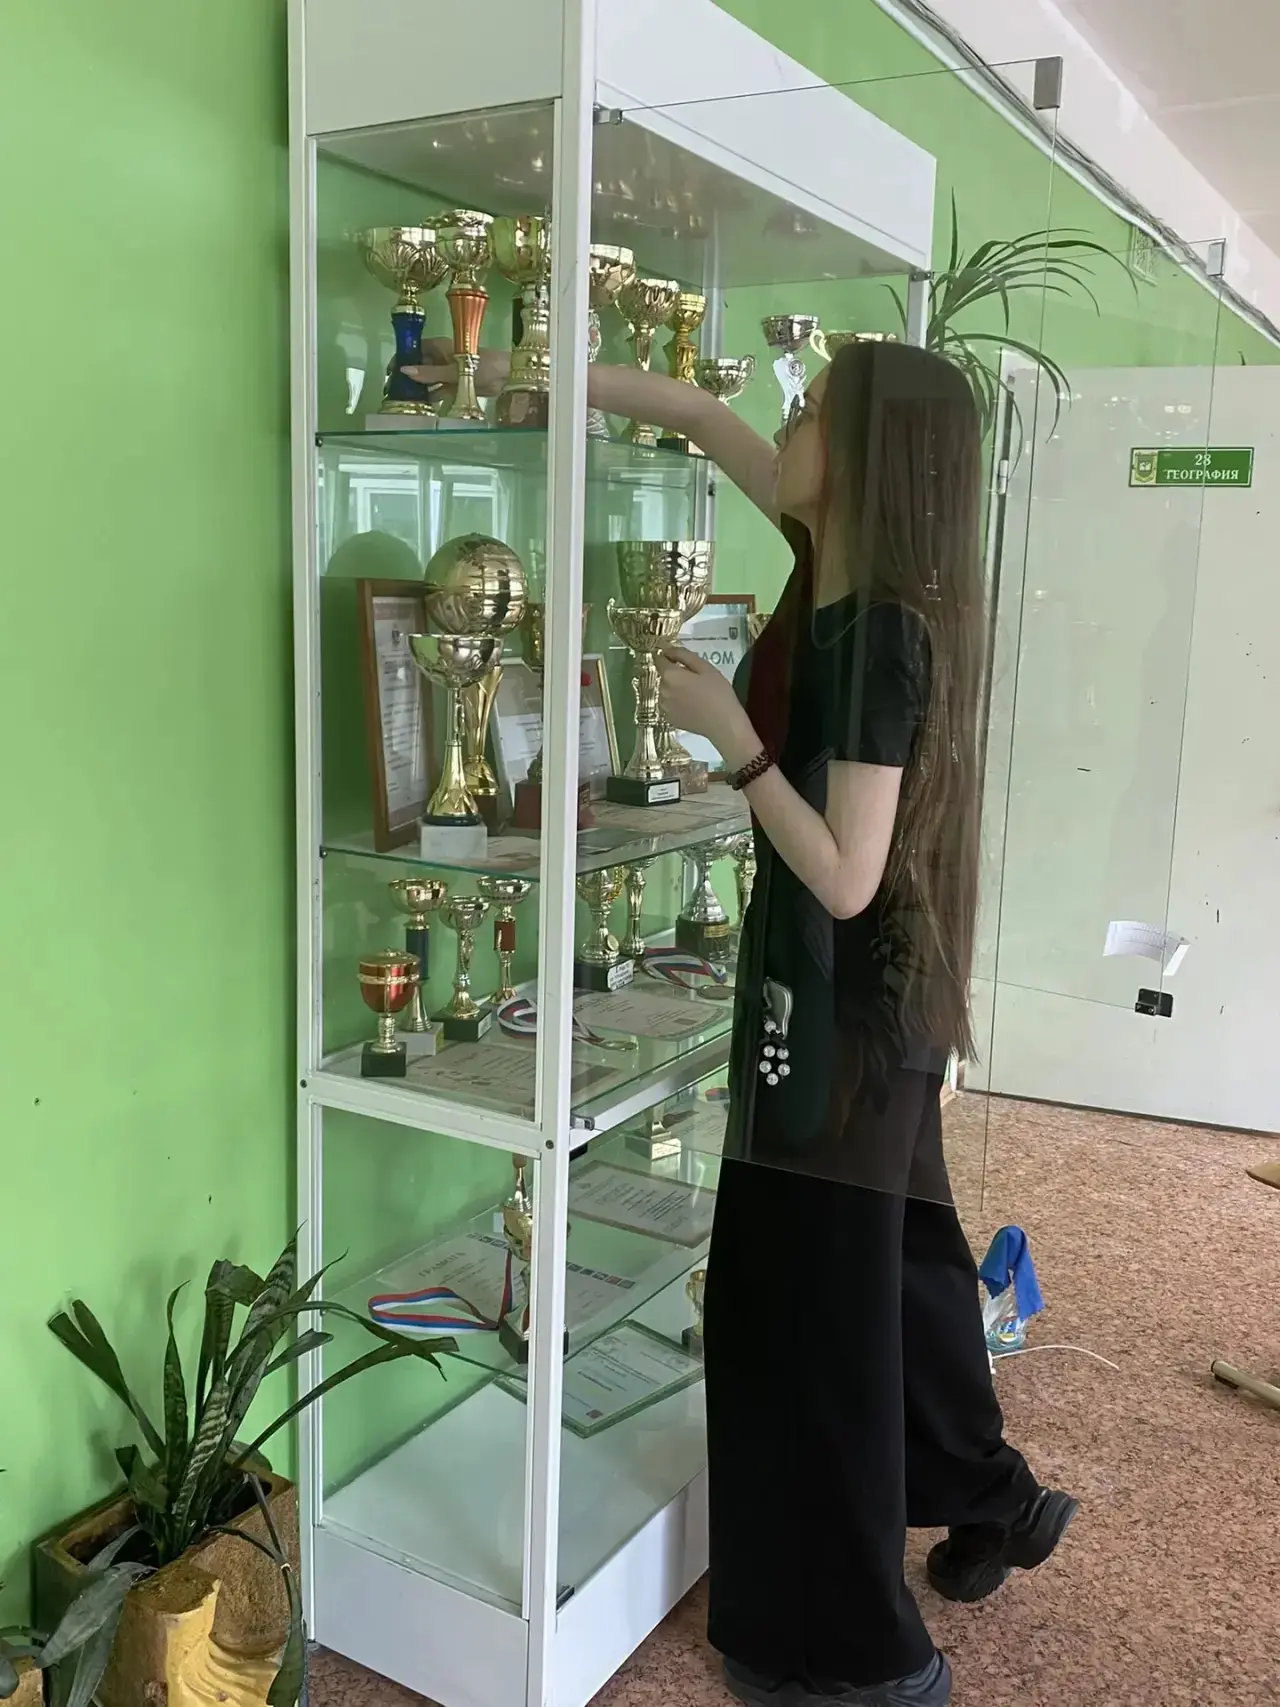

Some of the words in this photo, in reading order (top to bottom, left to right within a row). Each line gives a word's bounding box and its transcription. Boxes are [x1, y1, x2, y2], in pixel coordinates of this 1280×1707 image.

[1195, 453, 1212, 466] 28
[1166, 468, 1239, 480] ГЕОГРАФИЯ
[702, 651, 735, 665] ЛОМ
